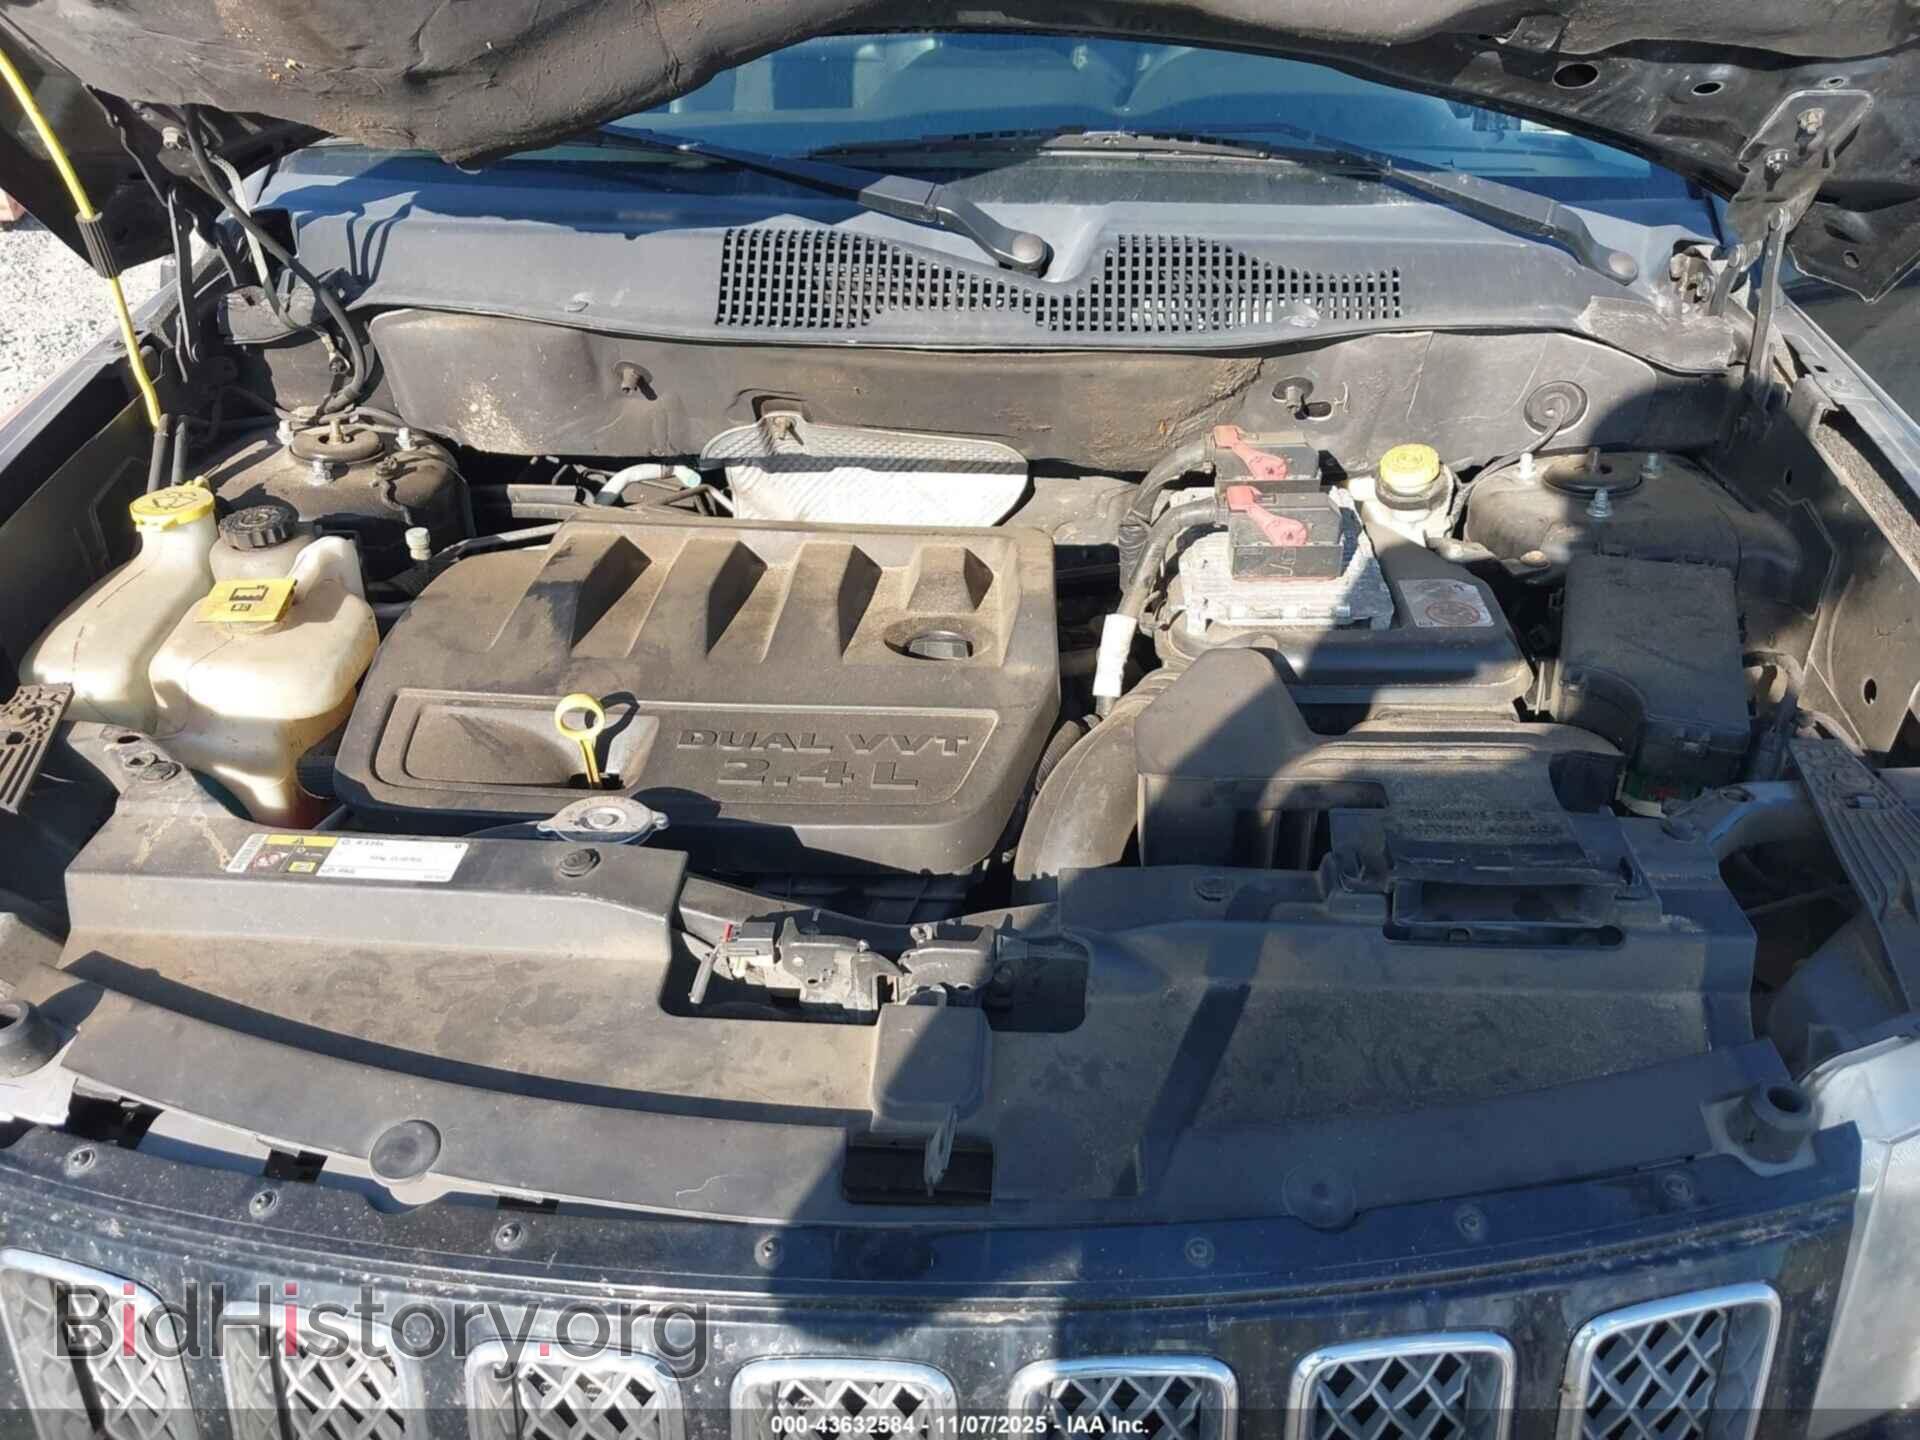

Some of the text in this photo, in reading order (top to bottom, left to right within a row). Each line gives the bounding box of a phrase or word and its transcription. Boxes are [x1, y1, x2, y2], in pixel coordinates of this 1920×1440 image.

[677, 730, 969, 757] DUAL VVT
[717, 757, 920, 790] 2.4L
